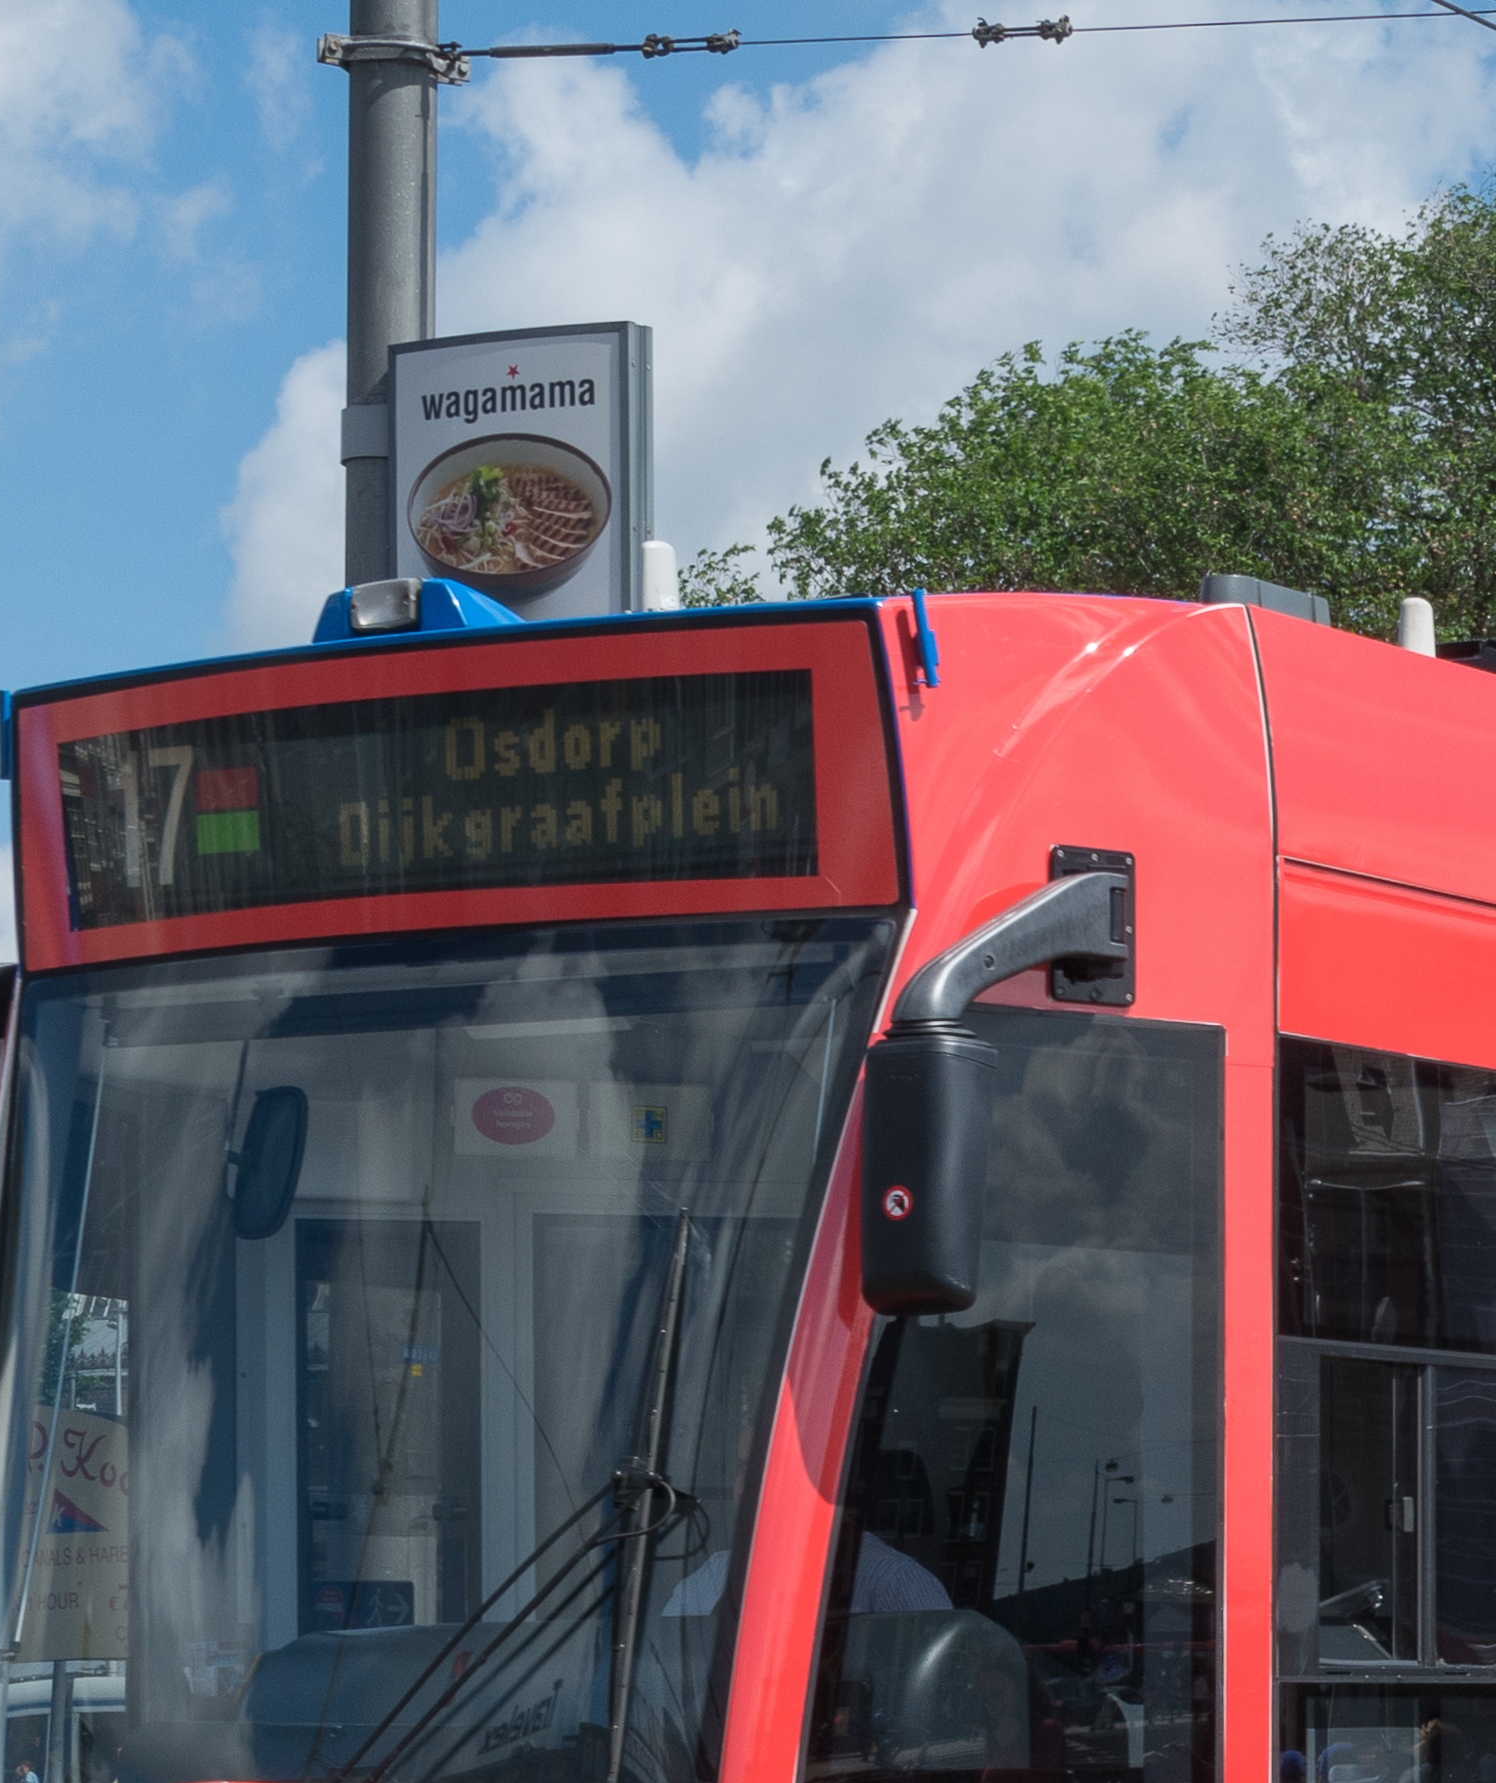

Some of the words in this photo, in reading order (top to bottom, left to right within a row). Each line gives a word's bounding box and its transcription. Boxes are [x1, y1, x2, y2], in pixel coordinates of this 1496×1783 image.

[421, 378, 595, 424] wagamama
[444, 708, 662, 781] Osdorp
[109, 744, 194, 888] 17
[338, 767, 780, 867] Dijkgraafplein
[75, 1548, 85, 1564] &
[38, 1592, 80, 1611] HOUR
